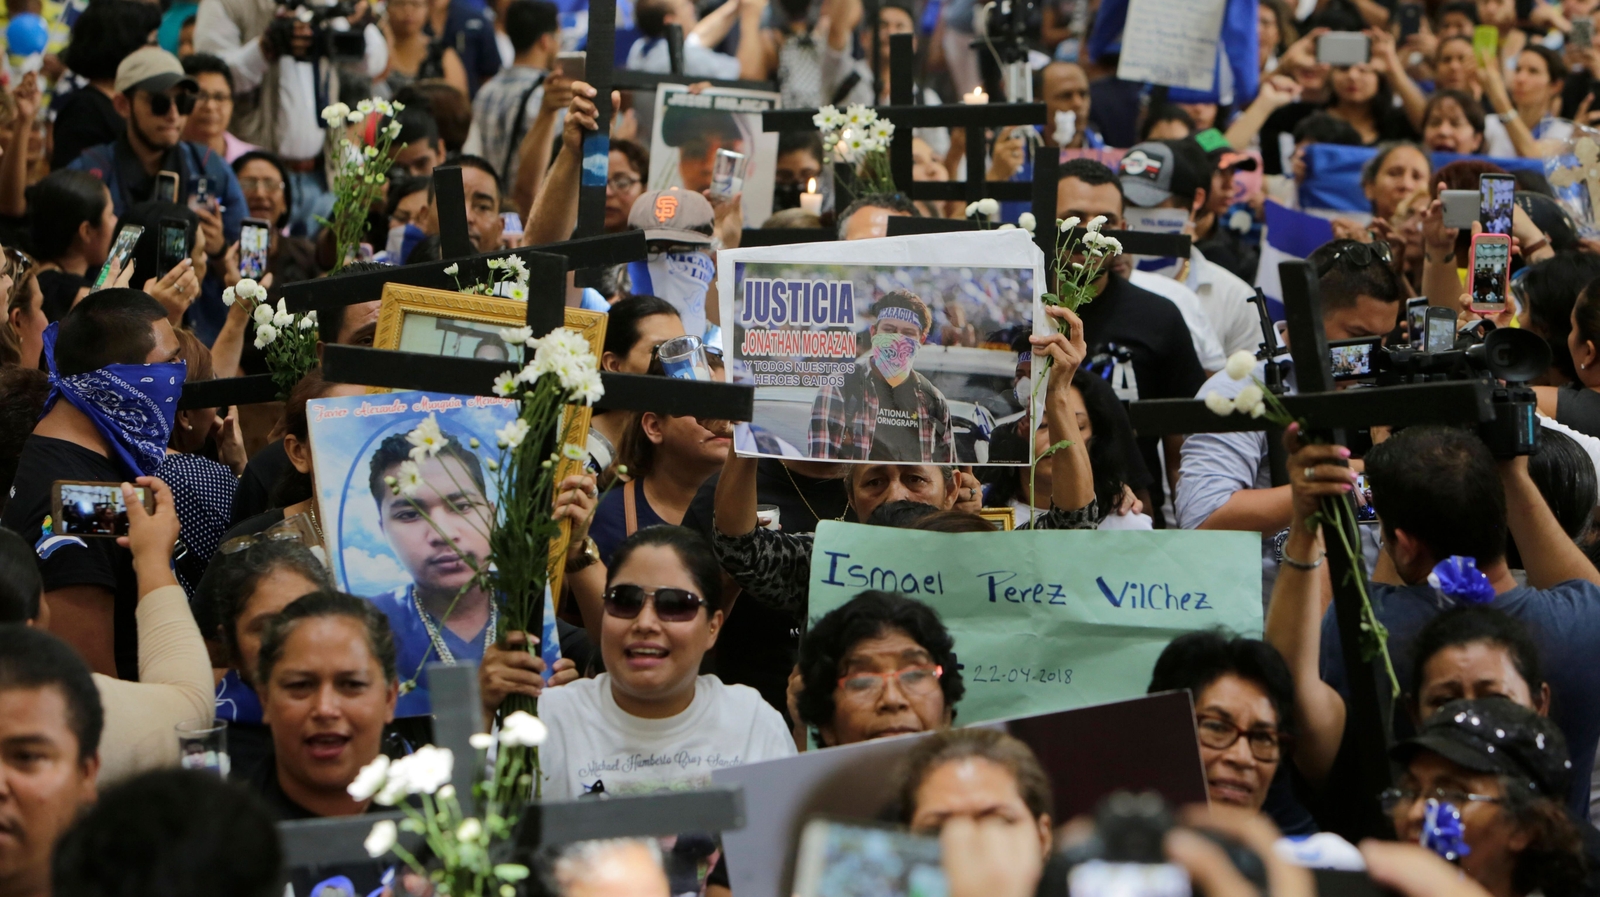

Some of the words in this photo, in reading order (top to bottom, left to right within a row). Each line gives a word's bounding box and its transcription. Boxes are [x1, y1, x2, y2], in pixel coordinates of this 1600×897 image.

[742, 280, 855, 325] JUSTICIA
[742, 330, 800, 355] JONATHAN
[803, 332, 857, 357] MORAZAN
[743, 361, 752, 372] Y
[755, 361, 792, 373] TODOS
[795, 362, 855, 374] NUESTROS
[754, 374, 800, 386] HEROES
[802, 375, 845, 387] CAIDOS
[313, 405, 348, 422] Javier
[354, 398, 408, 417] Alexander
[821, 551, 943, 595] Ismael
[976, 570, 1067, 606] Perez
[972, 665, 1073, 684] 22-04-2018
[622, 754, 672, 773] Humberto
